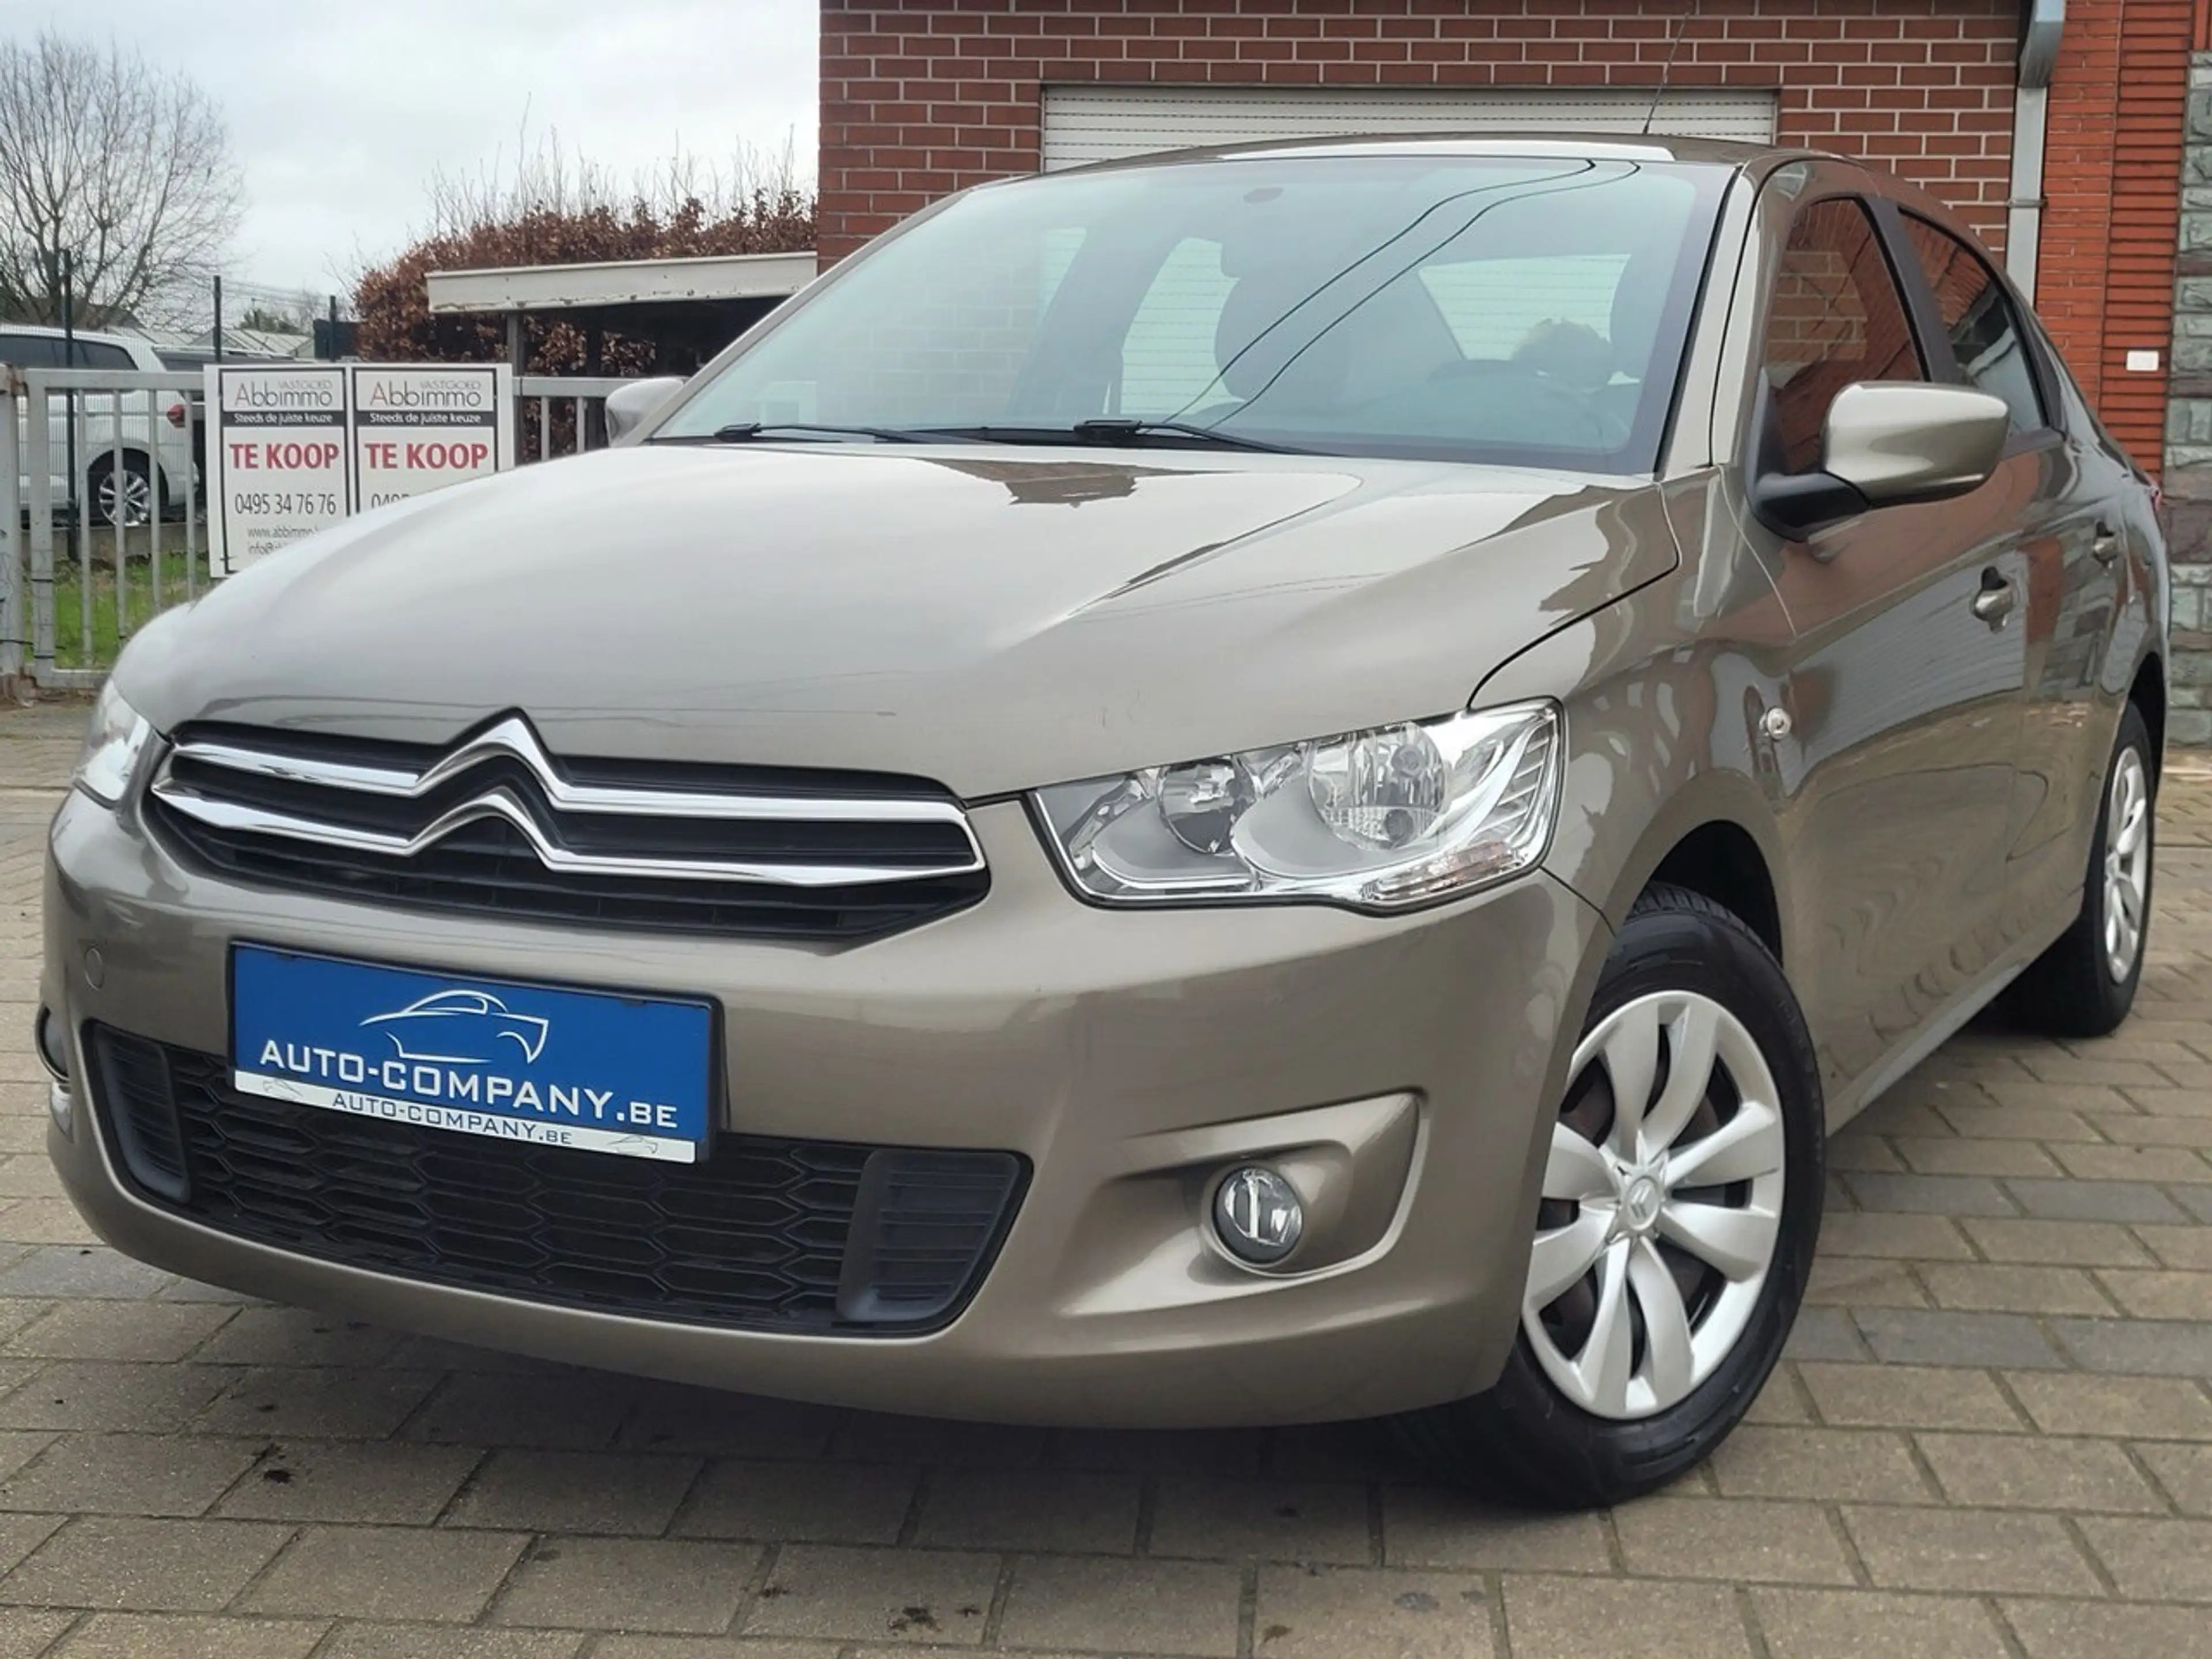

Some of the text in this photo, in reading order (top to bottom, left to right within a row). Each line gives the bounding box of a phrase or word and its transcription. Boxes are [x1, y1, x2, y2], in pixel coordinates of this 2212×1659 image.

[235, 380, 333, 407] Abbimmo
[369, 380, 482, 407] Abbimmo
[420, 380, 482, 389] VASTGOED
[234, 412, 264, 423] Steeds
[369, 412, 482, 425] Steeds de juiste keuze
[229, 442, 340, 469] TE KOOP
[364, 442, 488, 469] TE KOOP
[234, 493, 336, 514] 0495 34 76 76
[260, 1039, 678, 1128] AUTO-COMPANY.BE
[331, 1092, 572, 1145] AUTO-COMPANY.BE
